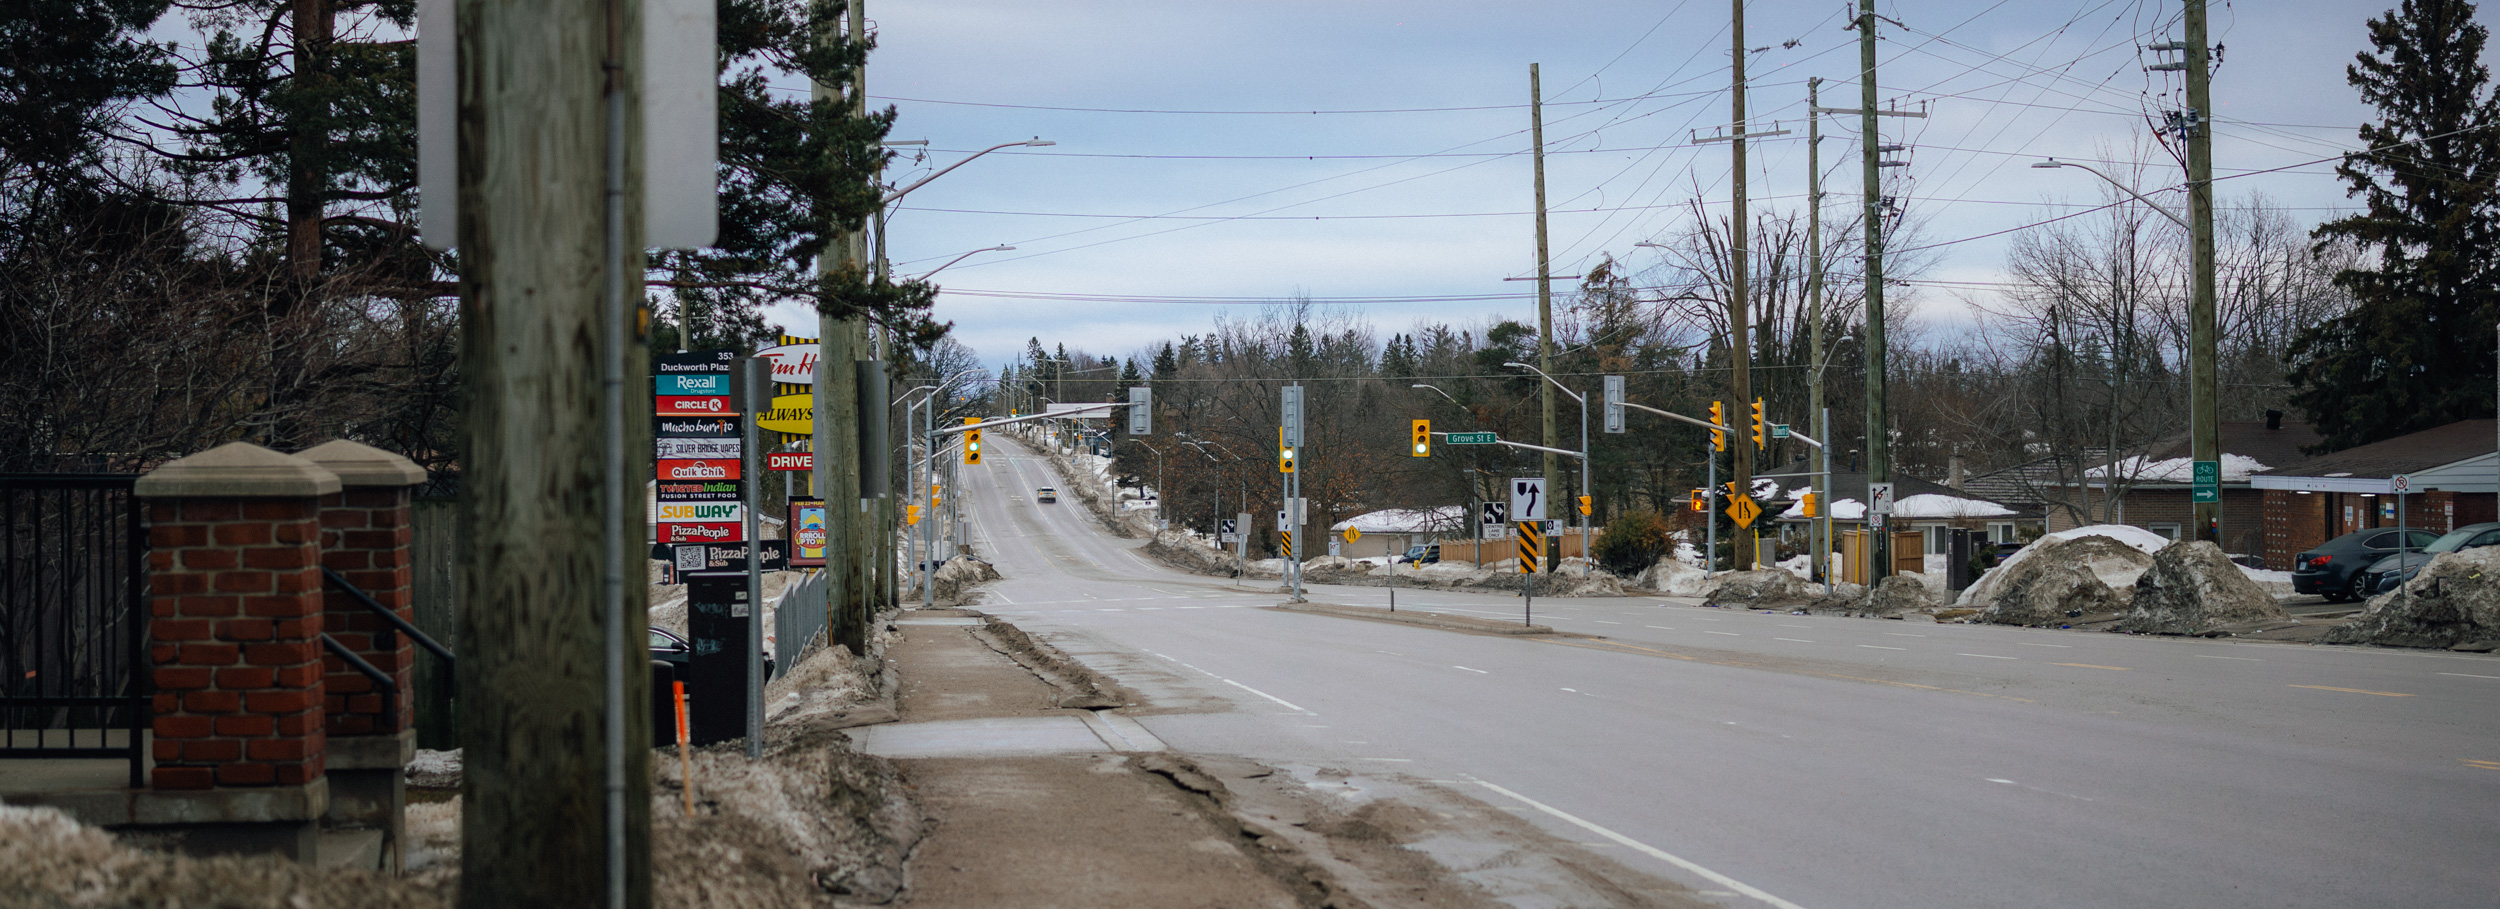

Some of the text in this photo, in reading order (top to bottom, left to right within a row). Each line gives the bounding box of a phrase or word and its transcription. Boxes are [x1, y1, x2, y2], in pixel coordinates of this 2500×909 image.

[718, 352, 733, 360] 353
[661, 363, 730, 371] Duckworth Plaz
[677, 376, 716, 390] Rexall
[675, 401, 707, 409] CIRCLE
[758, 408, 813, 421] ALWAYS
[676, 444, 739, 453] SILVER BRIDGE VAPES
[771, 456, 812, 468] DRIVE
[674, 467, 724, 476] Quik Chik
[703, 482, 736, 492] Indian
[660, 504, 738, 519] SUBWAY
